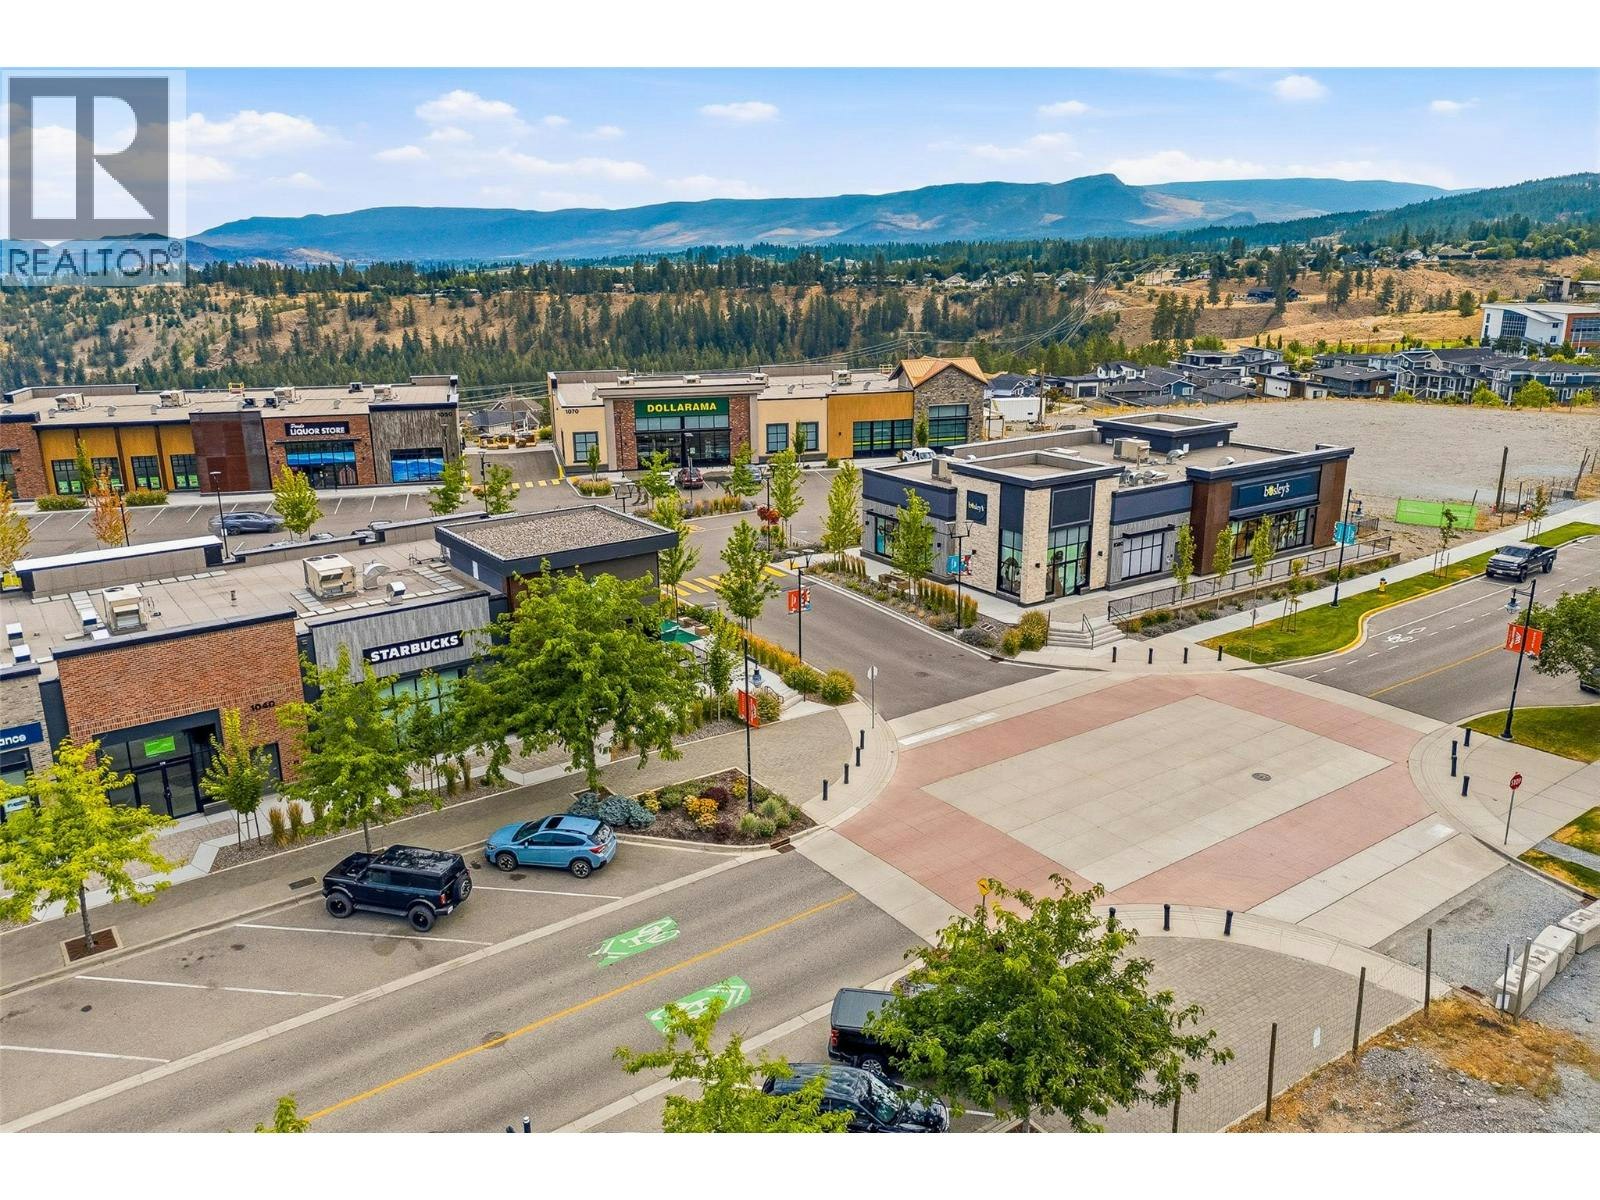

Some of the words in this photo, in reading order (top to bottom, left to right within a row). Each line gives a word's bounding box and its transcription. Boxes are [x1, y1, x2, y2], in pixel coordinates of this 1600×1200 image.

[647, 402, 717, 413] DOLLARAMA
[290, 427, 321, 436] LIQUOR
[321, 426, 345, 435] STORE
[370, 635, 459, 662] STARBUCKS
[250, 700, 276, 712] 1040
